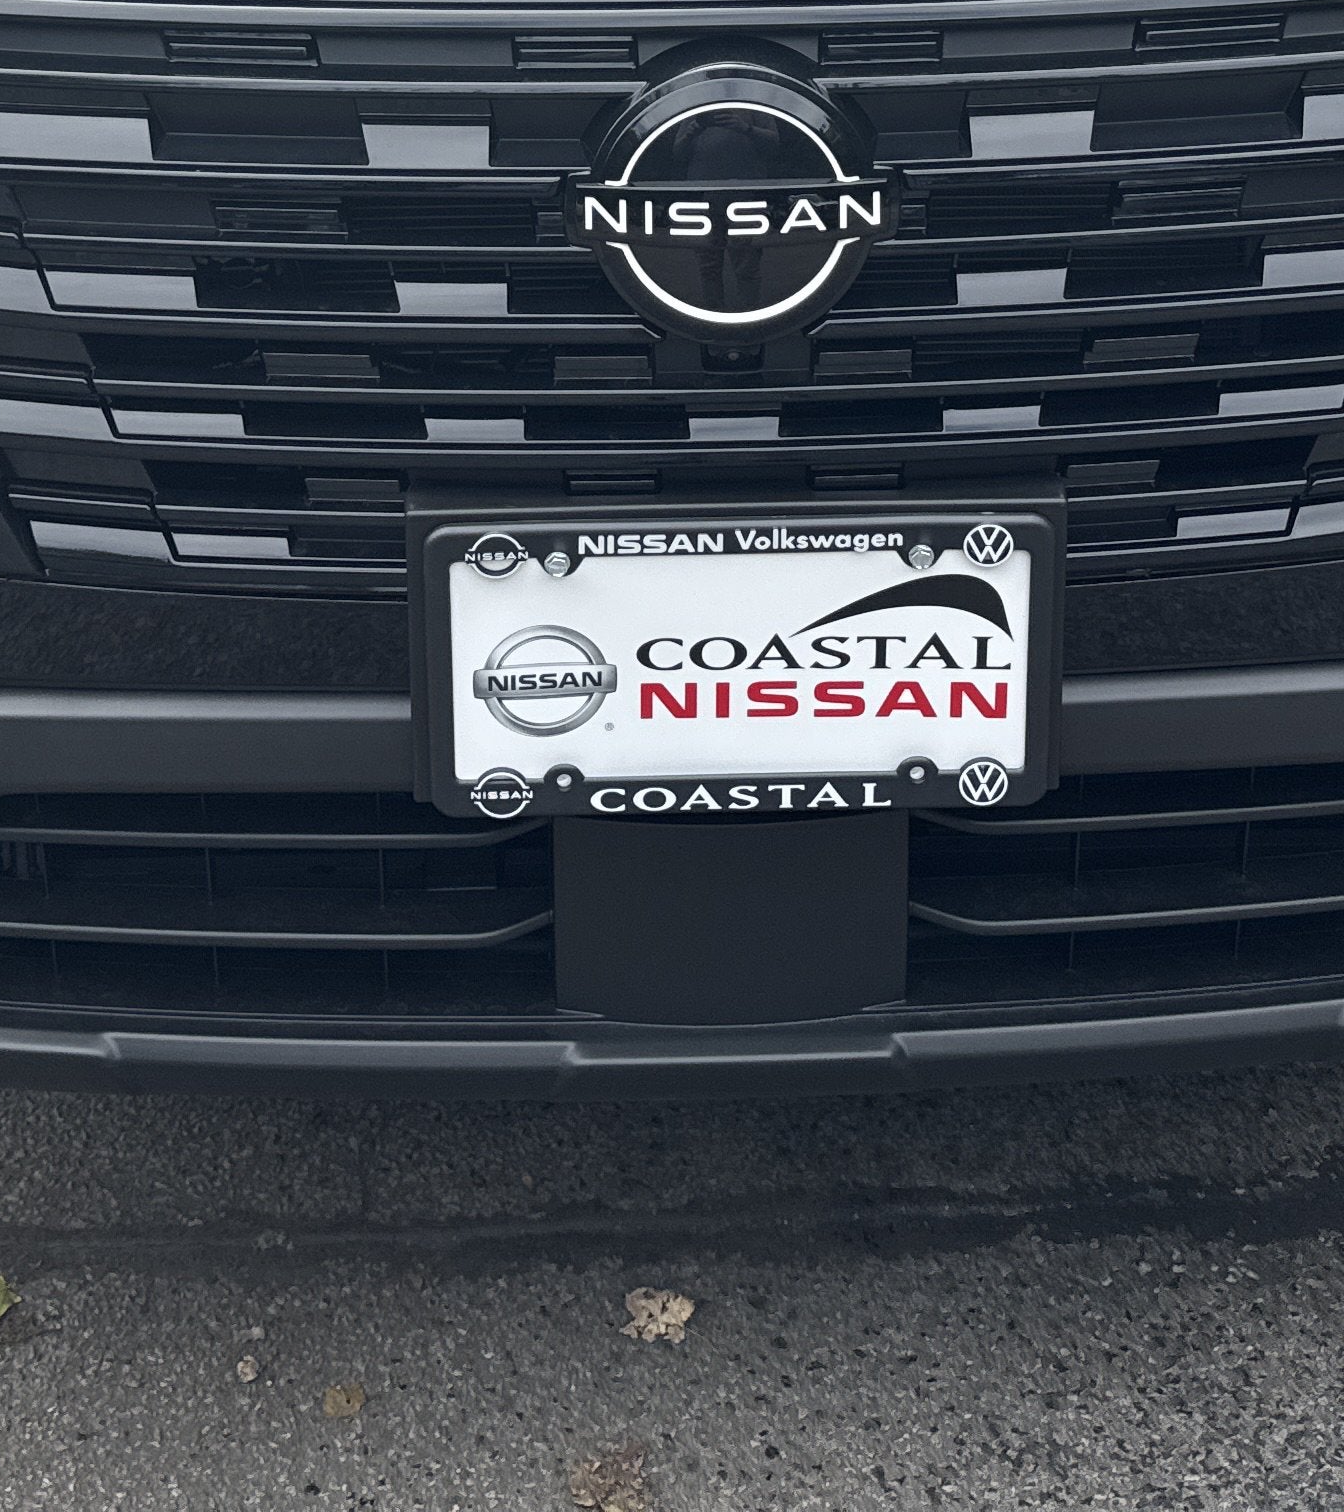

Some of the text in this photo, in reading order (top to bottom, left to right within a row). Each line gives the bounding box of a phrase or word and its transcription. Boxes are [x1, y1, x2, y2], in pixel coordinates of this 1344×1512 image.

[584, 190, 881, 236] NISSAN
[464, 550, 529, 562] NISSAN
[578, 527, 904, 555] NISSAN Volkswagen
[636, 632, 1012, 671] COASTAL
[488, 671, 603, 692] NISSAN
[640, 680, 1008, 720] NISSAN
[470, 789, 534, 800] NISSAN
[590, 781, 892, 813] COASTAL
